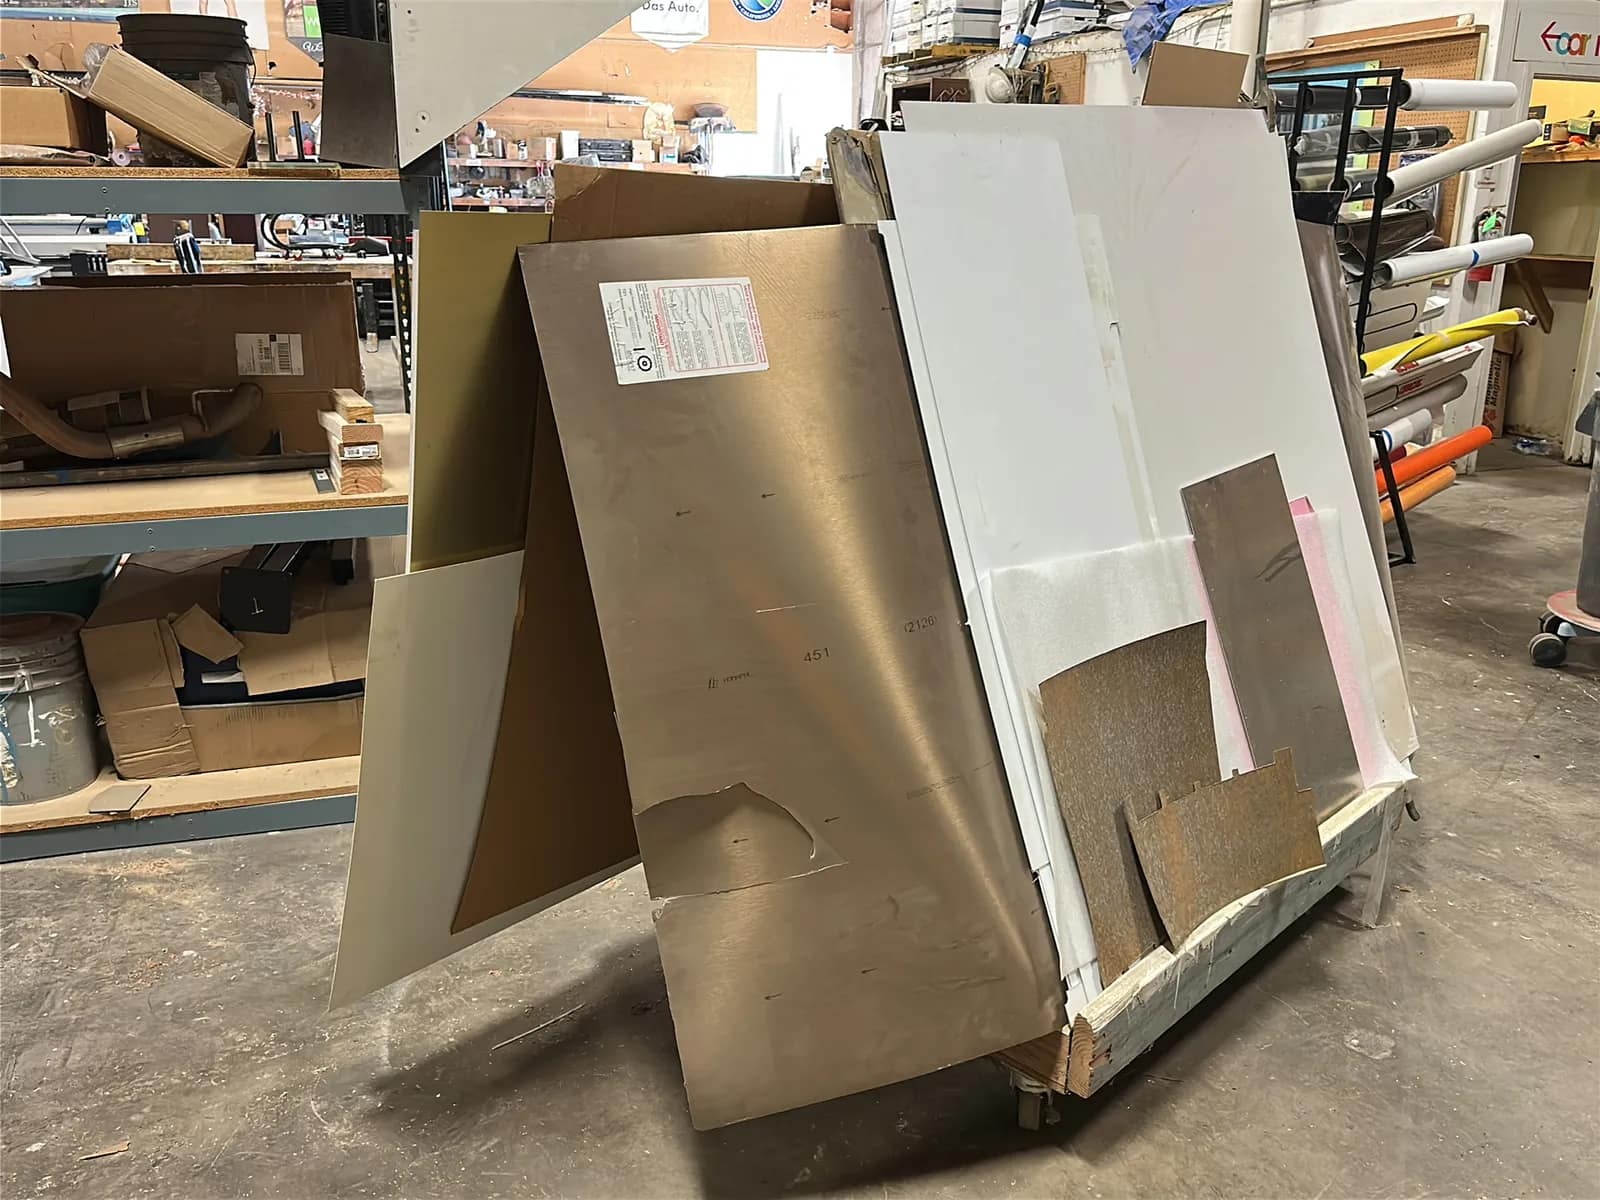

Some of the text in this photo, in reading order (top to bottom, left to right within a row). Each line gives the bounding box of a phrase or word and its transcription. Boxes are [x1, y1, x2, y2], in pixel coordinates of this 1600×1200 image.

[642, 0, 700, 13] Das Auto.
[1556, 32, 1592, 56] car
